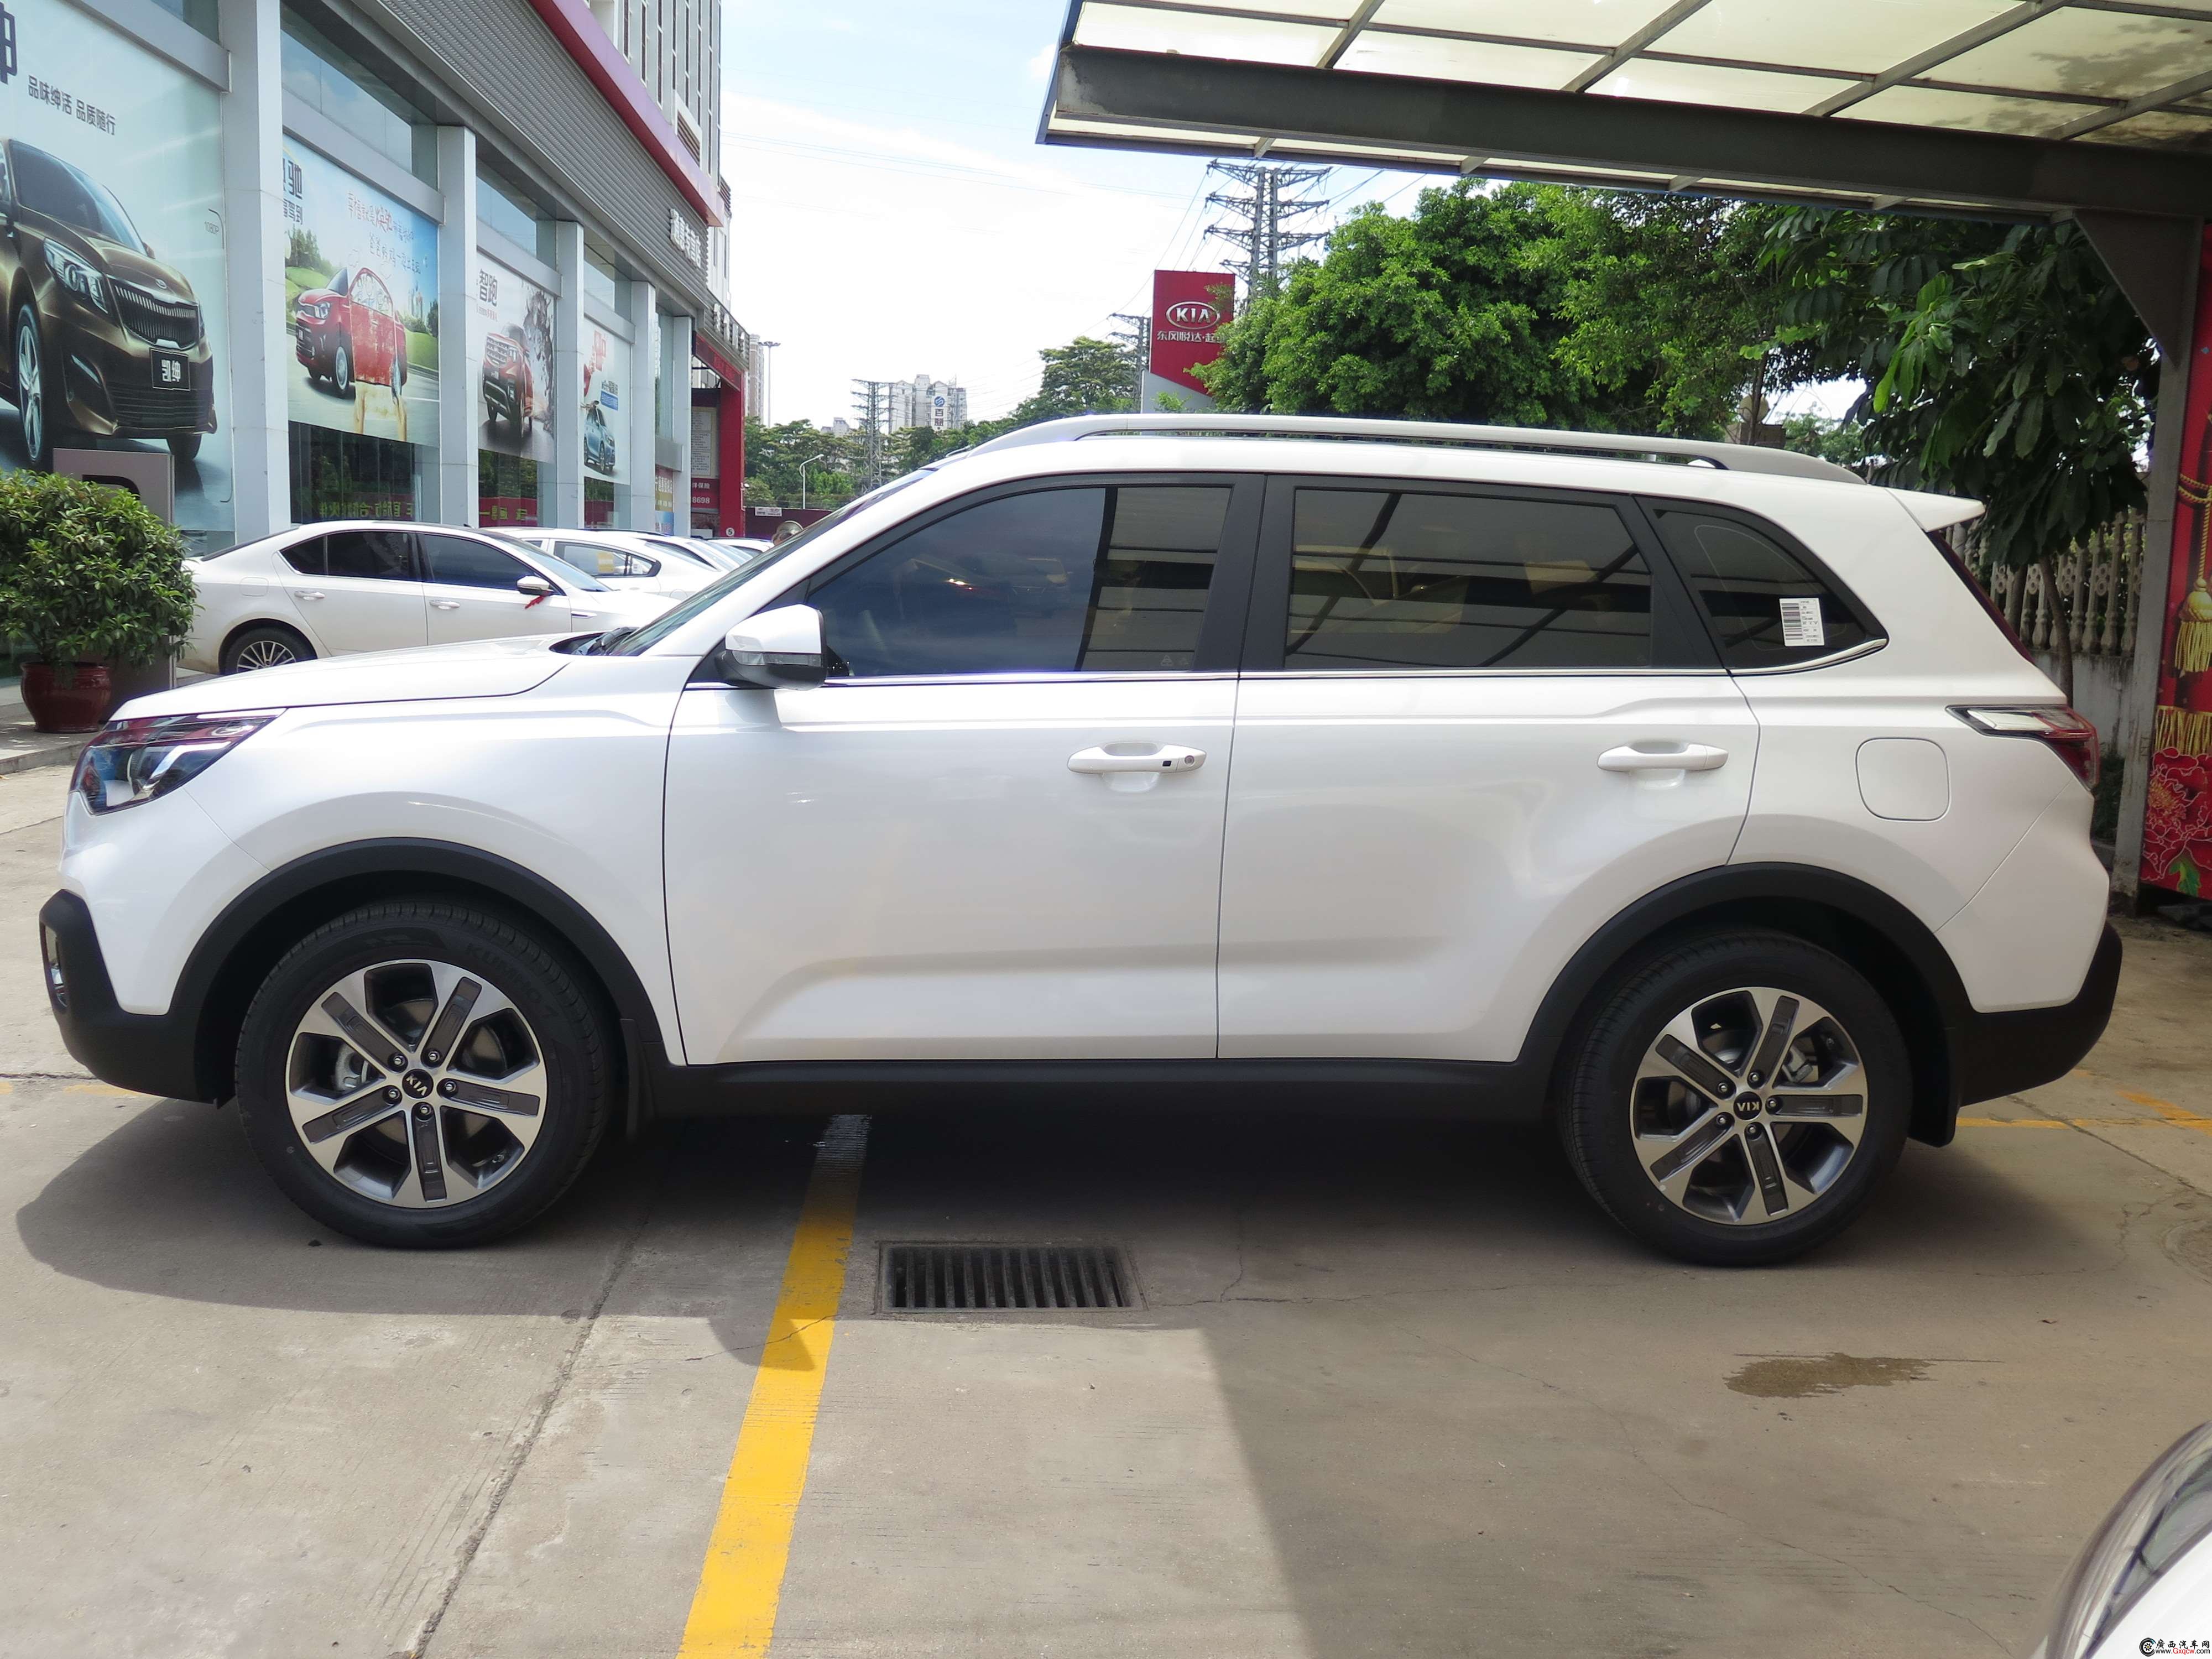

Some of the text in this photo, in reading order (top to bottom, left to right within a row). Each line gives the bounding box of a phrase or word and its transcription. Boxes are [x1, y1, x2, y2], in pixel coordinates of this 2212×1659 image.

[28, 75, 116, 135] 品味绅活 品质随行
[283, 158, 302, 200] 驰
[479, 269, 498, 307] 智跑
[1176, 307, 1211, 324] KIA
[1157, 331, 1221, 344] 东风悦达·起
[161, 359, 181, 382] 凯绅
[406, 1074, 427, 1096] KIA
[1736, 1102, 1760, 1112] KIA
